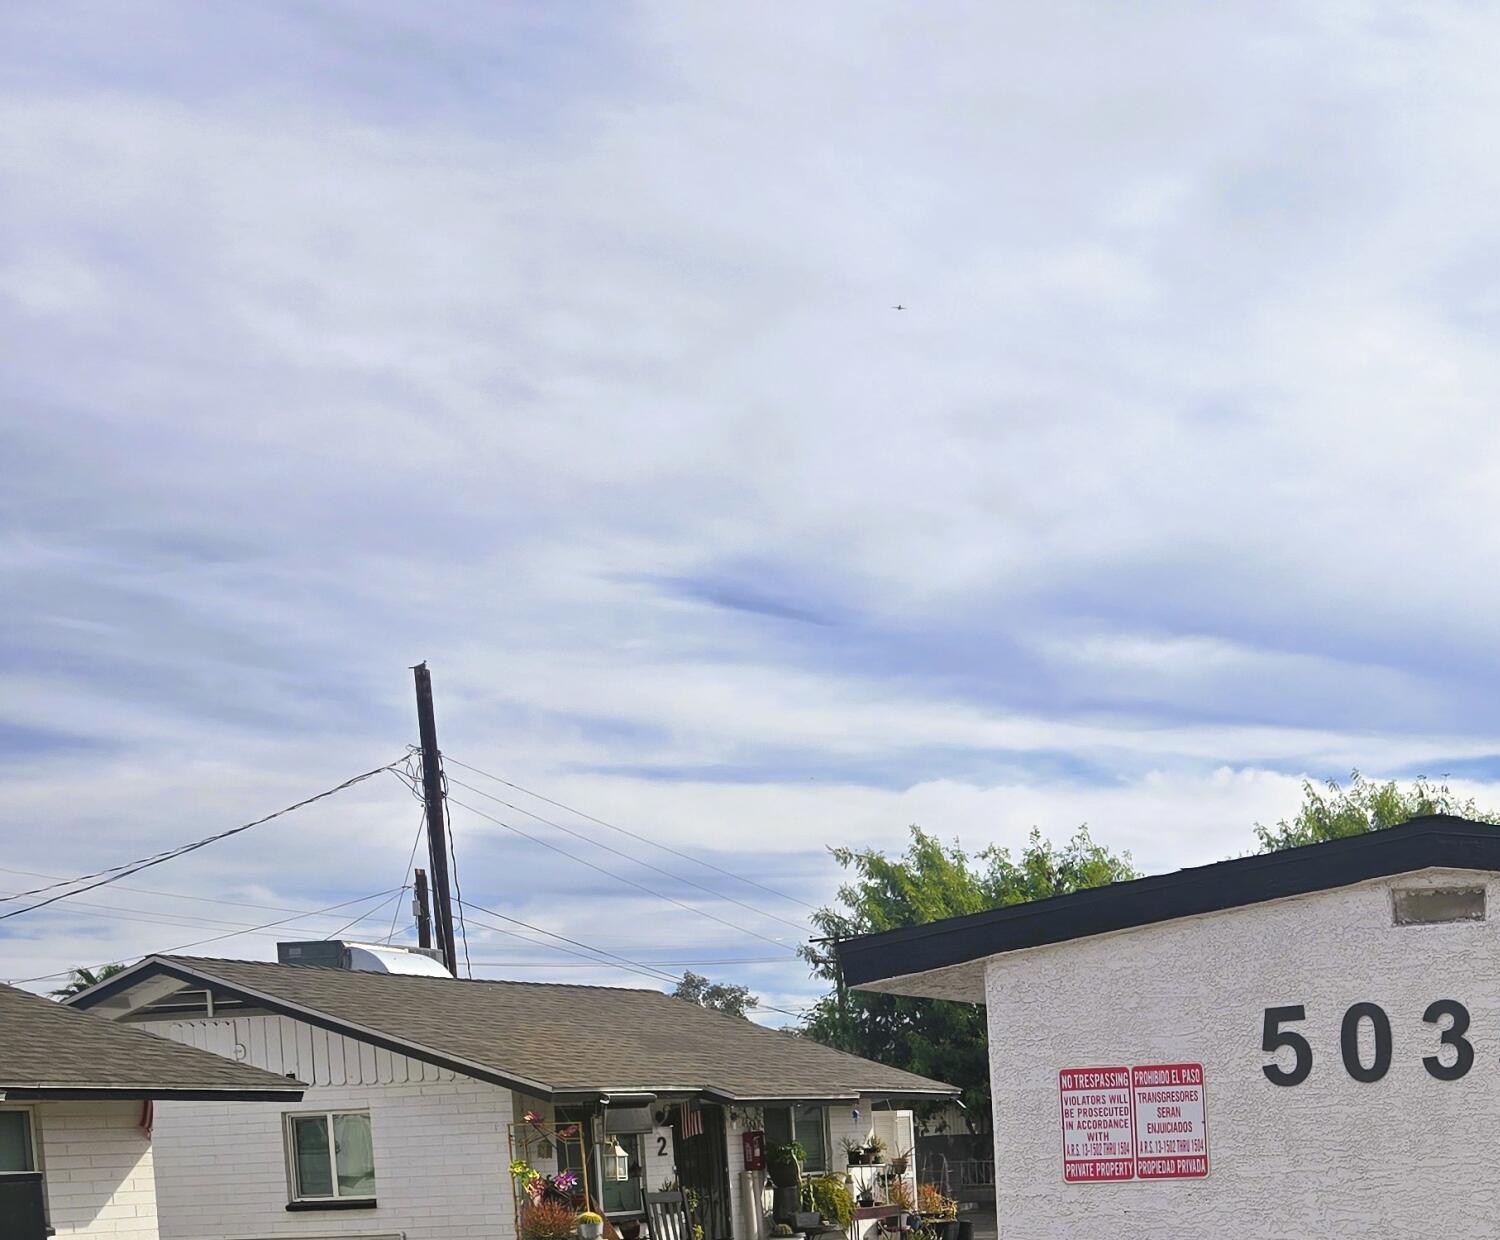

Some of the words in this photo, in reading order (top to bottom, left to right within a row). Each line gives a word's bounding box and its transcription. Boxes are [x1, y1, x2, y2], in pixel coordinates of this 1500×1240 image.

[1062, 1075, 1072, 1089] NO
[1074, 1073, 1128, 1088] TRESPASSING
[1134, 1070, 1169, 1085] PROHIBIDO
[1172, 1071, 1180, 1084] EL
[1182, 1069, 1200, 1083] PASO
[1064, 1095, 1106, 1105] VIOLATORS
[1109, 1094, 1128, 1104] WILL
[1137, 1091, 1198, 1103] TRANSGRESORES
[1064, 1108, 1074, 1118] BE
[1077, 1107, 1129, 1117] PROSECUTED
[1157, 1107, 1181, 1118] SERAN
[1066, 1121, 1073, 1130] IN
[1077, 1119, 1129, 1129] ACCORDANCE
[1147, 1121, 1193, 1134] ENJUICIADOS
[1087, 1132, 1109, 1141] WITH
[657, 1136, 668, 1157] 2
[1066, 1163, 1094, 1177] PRIVATE
[1096, 1161, 1133, 1176] PROPERTY
[1138, 1160, 1175, 1174] PROPIEDAD
[1177, 1159, 1205, 1173] PRIVADA
